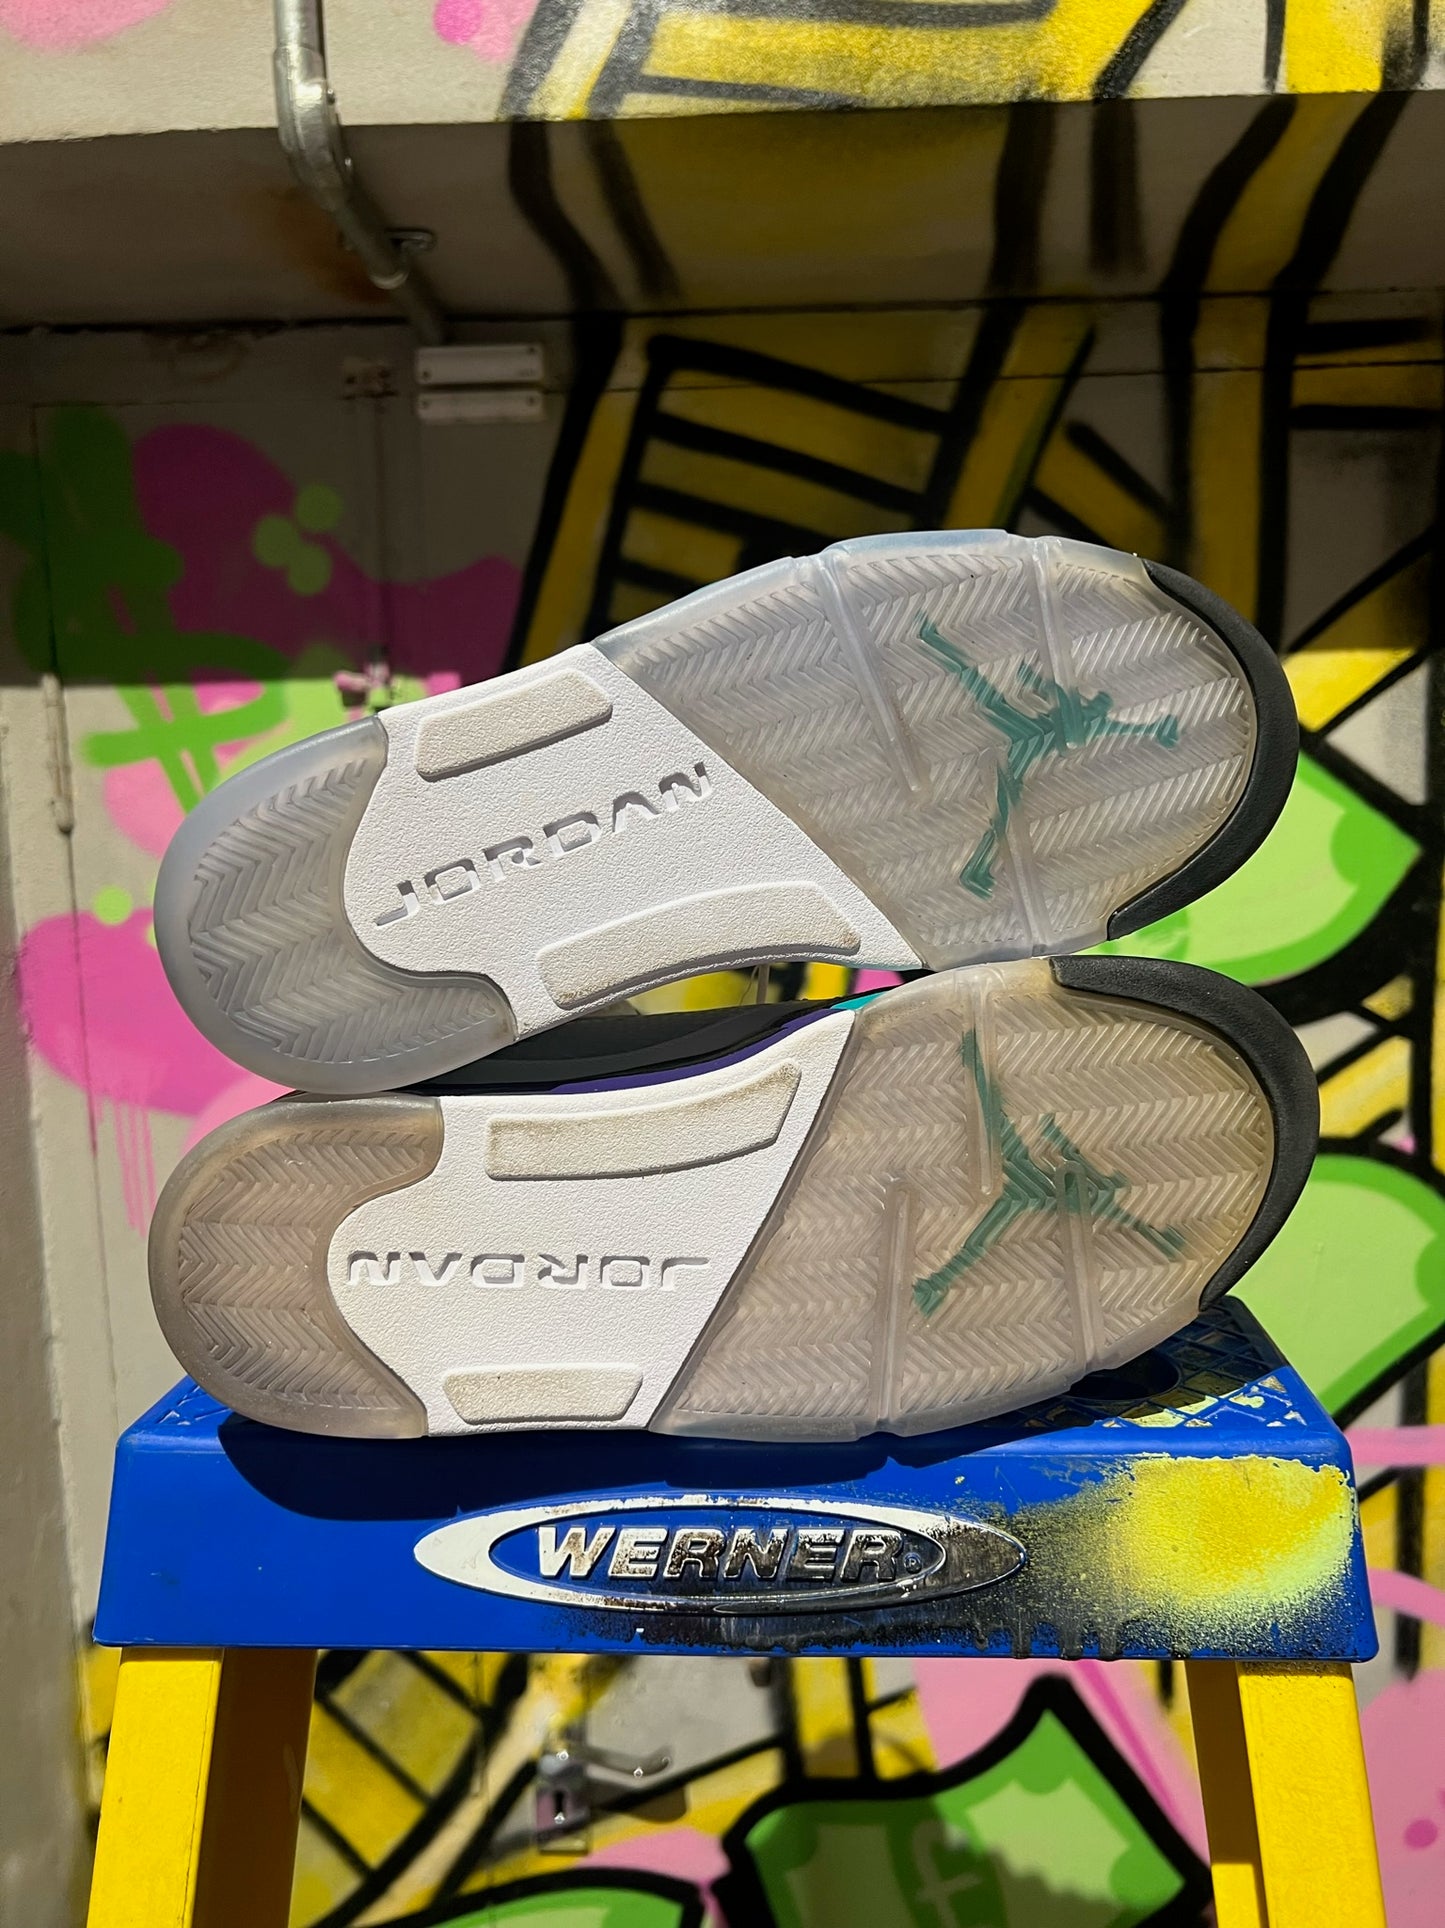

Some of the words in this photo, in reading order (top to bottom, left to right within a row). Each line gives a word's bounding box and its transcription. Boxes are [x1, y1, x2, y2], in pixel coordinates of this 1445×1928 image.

[375, 761, 712, 927] JORDAN
[347, 1251, 710, 1291] JORDAN
[538, 1526, 903, 1581] WERNER
